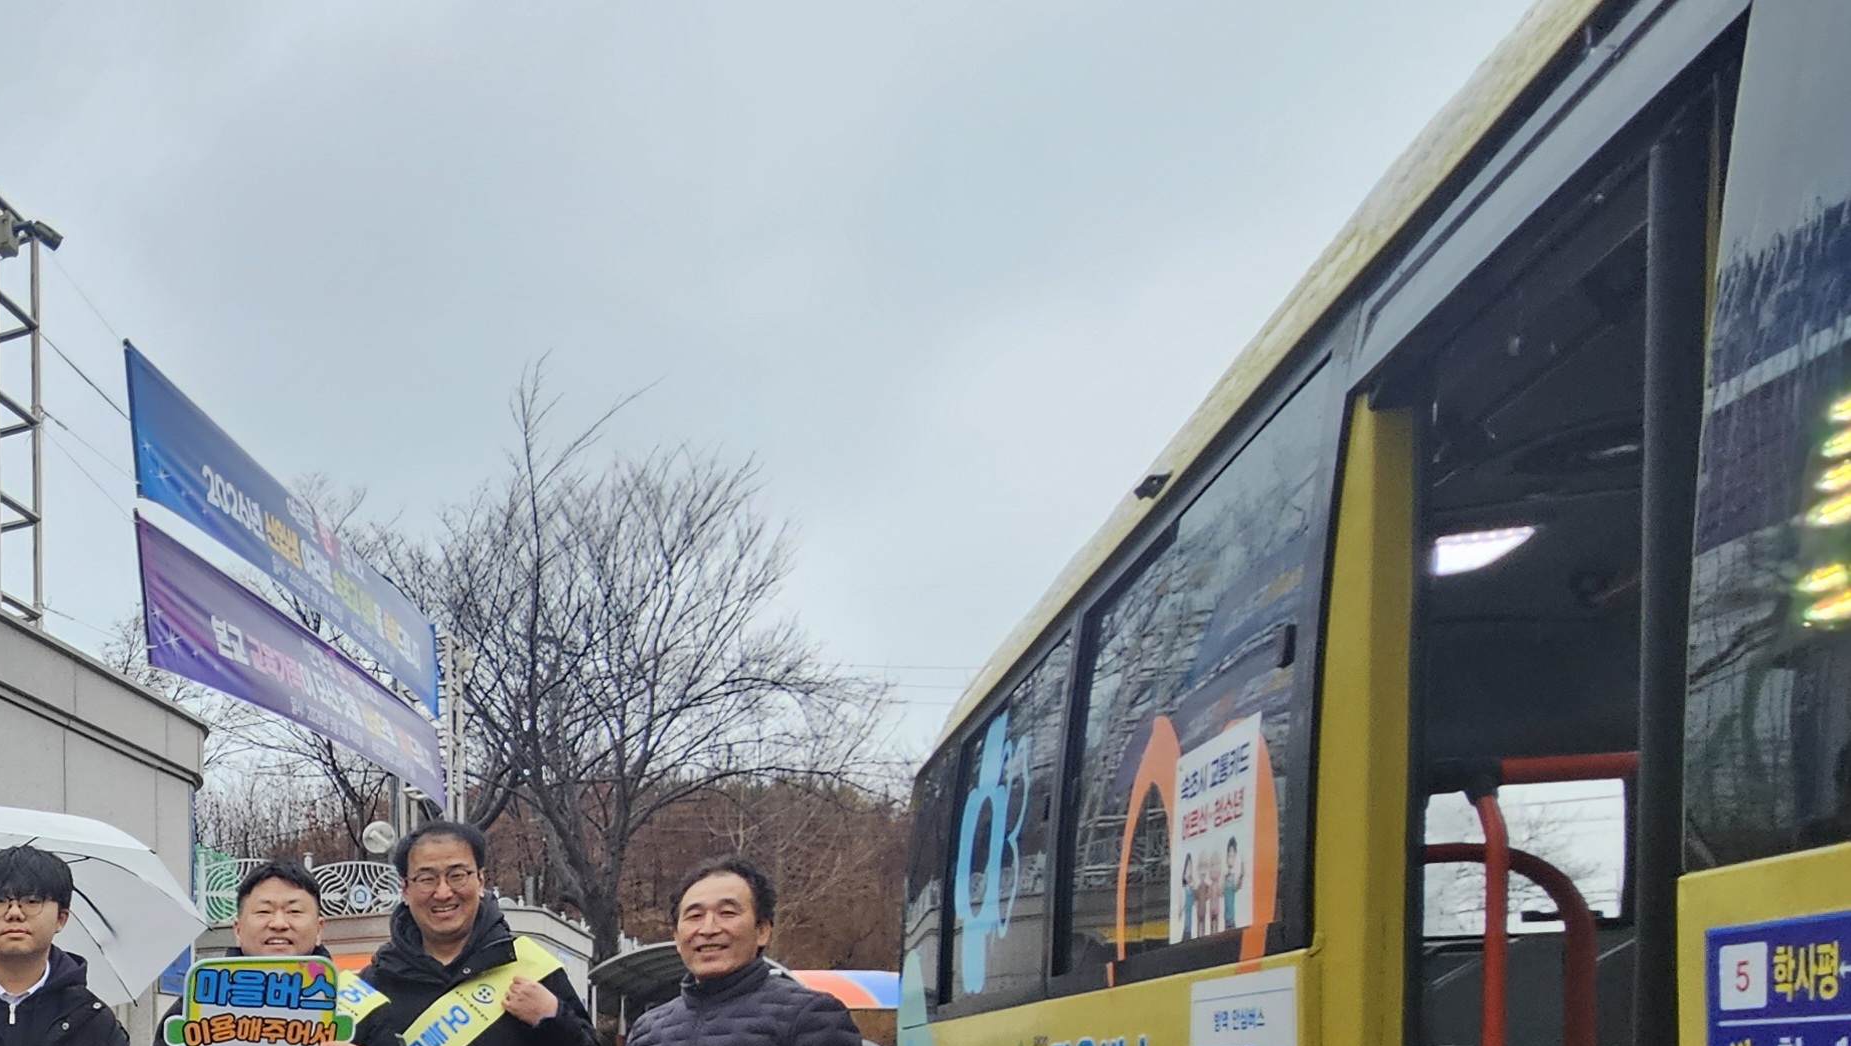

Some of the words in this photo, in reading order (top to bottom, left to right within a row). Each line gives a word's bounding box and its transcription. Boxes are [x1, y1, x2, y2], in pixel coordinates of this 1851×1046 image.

[202, 464, 266, 542] 2026년
[194, 968, 337, 1011] 마을버스
[1735, 959, 1750, 993] 5
[1772, 940, 1840, 1003] 학사평
